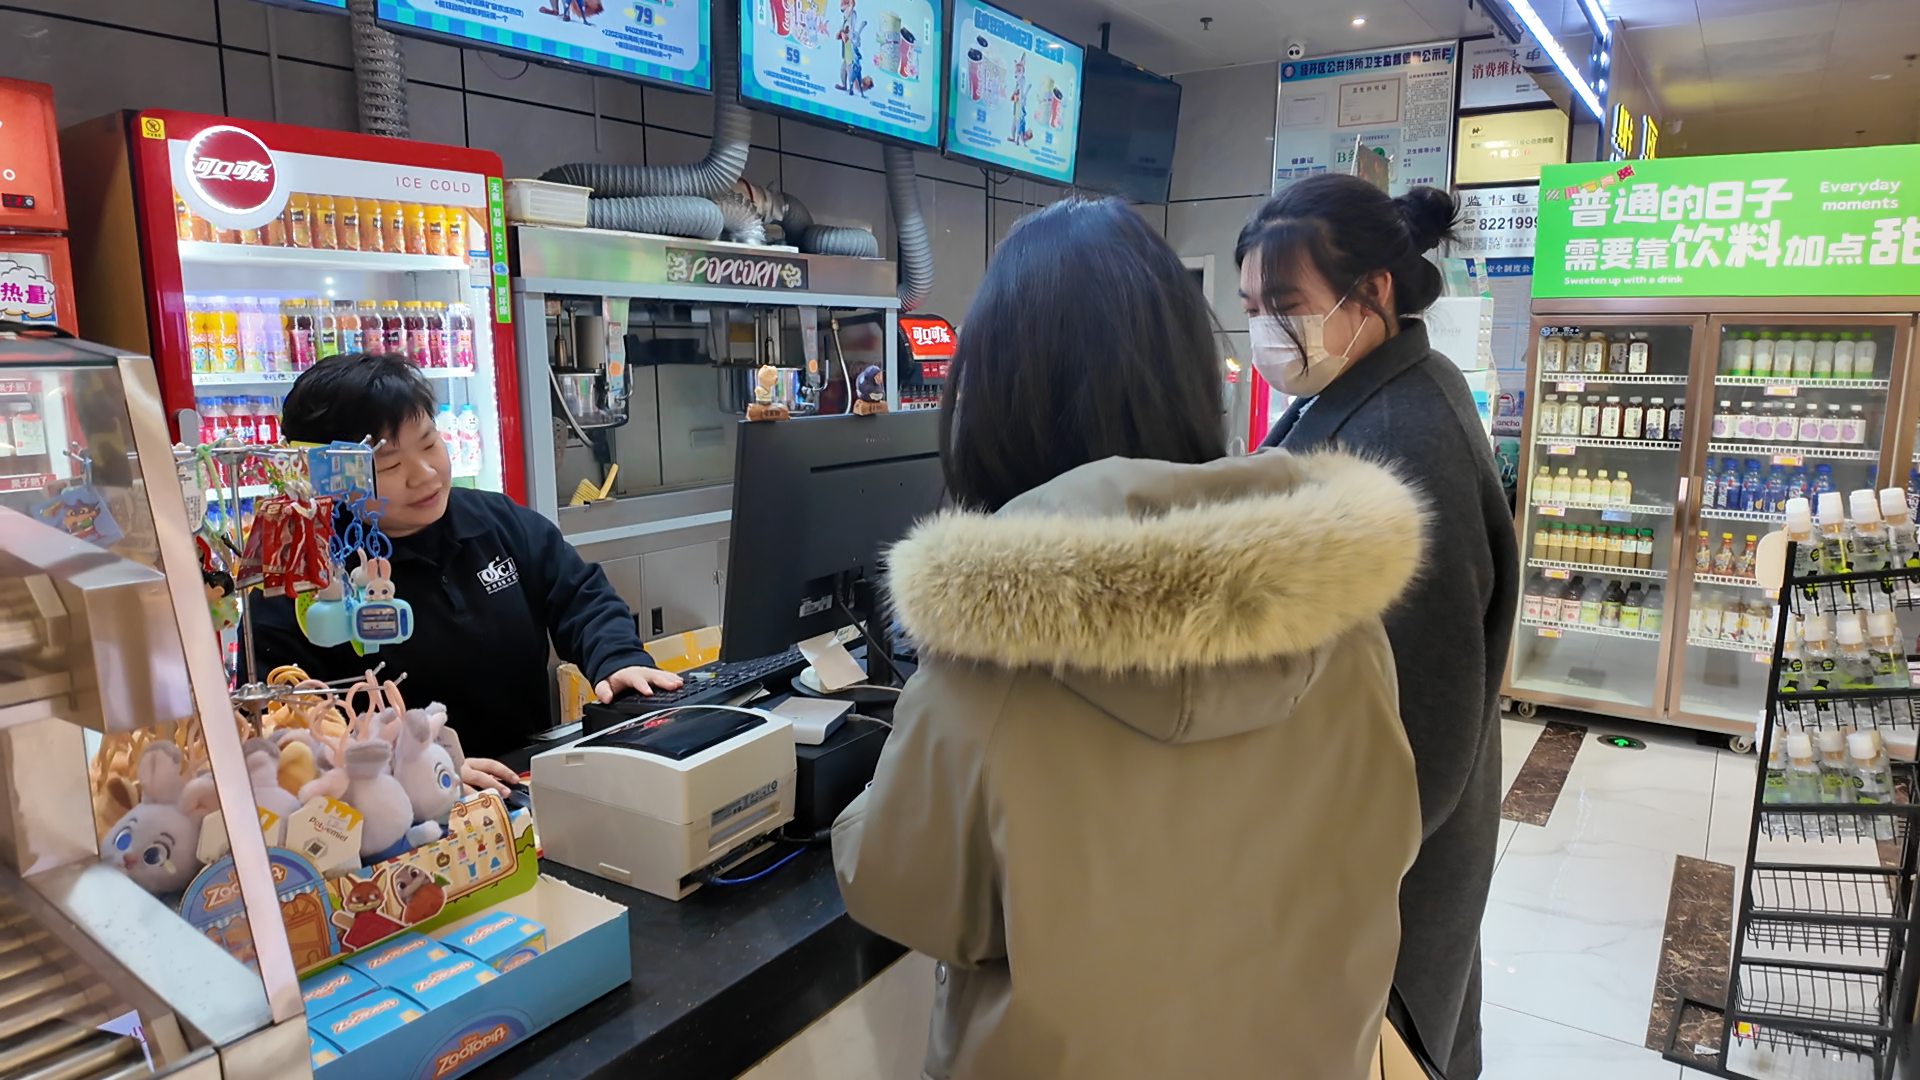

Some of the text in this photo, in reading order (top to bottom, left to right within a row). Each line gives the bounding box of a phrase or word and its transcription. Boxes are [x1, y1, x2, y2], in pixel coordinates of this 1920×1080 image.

[635, 5, 652, 25] 79
[786, 46, 800, 64] 59
[893, 81, 904, 96] 39
[194, 157, 272, 182] 可口可乐
[396, 176, 471, 193] ICE COLD
[1820, 179, 1901, 196] Everyday
[1570, 178, 1793, 226] 普通的日子
[1822, 197, 1899, 211] moments
[1565, 218, 1920, 270] 需要靠饮料加点甜
[690, 256, 783, 287] POPCORN
[1564, 276, 1607, 285] Sweeten
[1610, 278, 1622, 288] up
[1624, 274, 1648, 284] with
[1659, 274, 1684, 284] drink
[1, 283, 48, 304] 热量
[912, 325, 951, 345] 可口可乐
[435, 1024, 508, 1078] ZOOTOPIA
